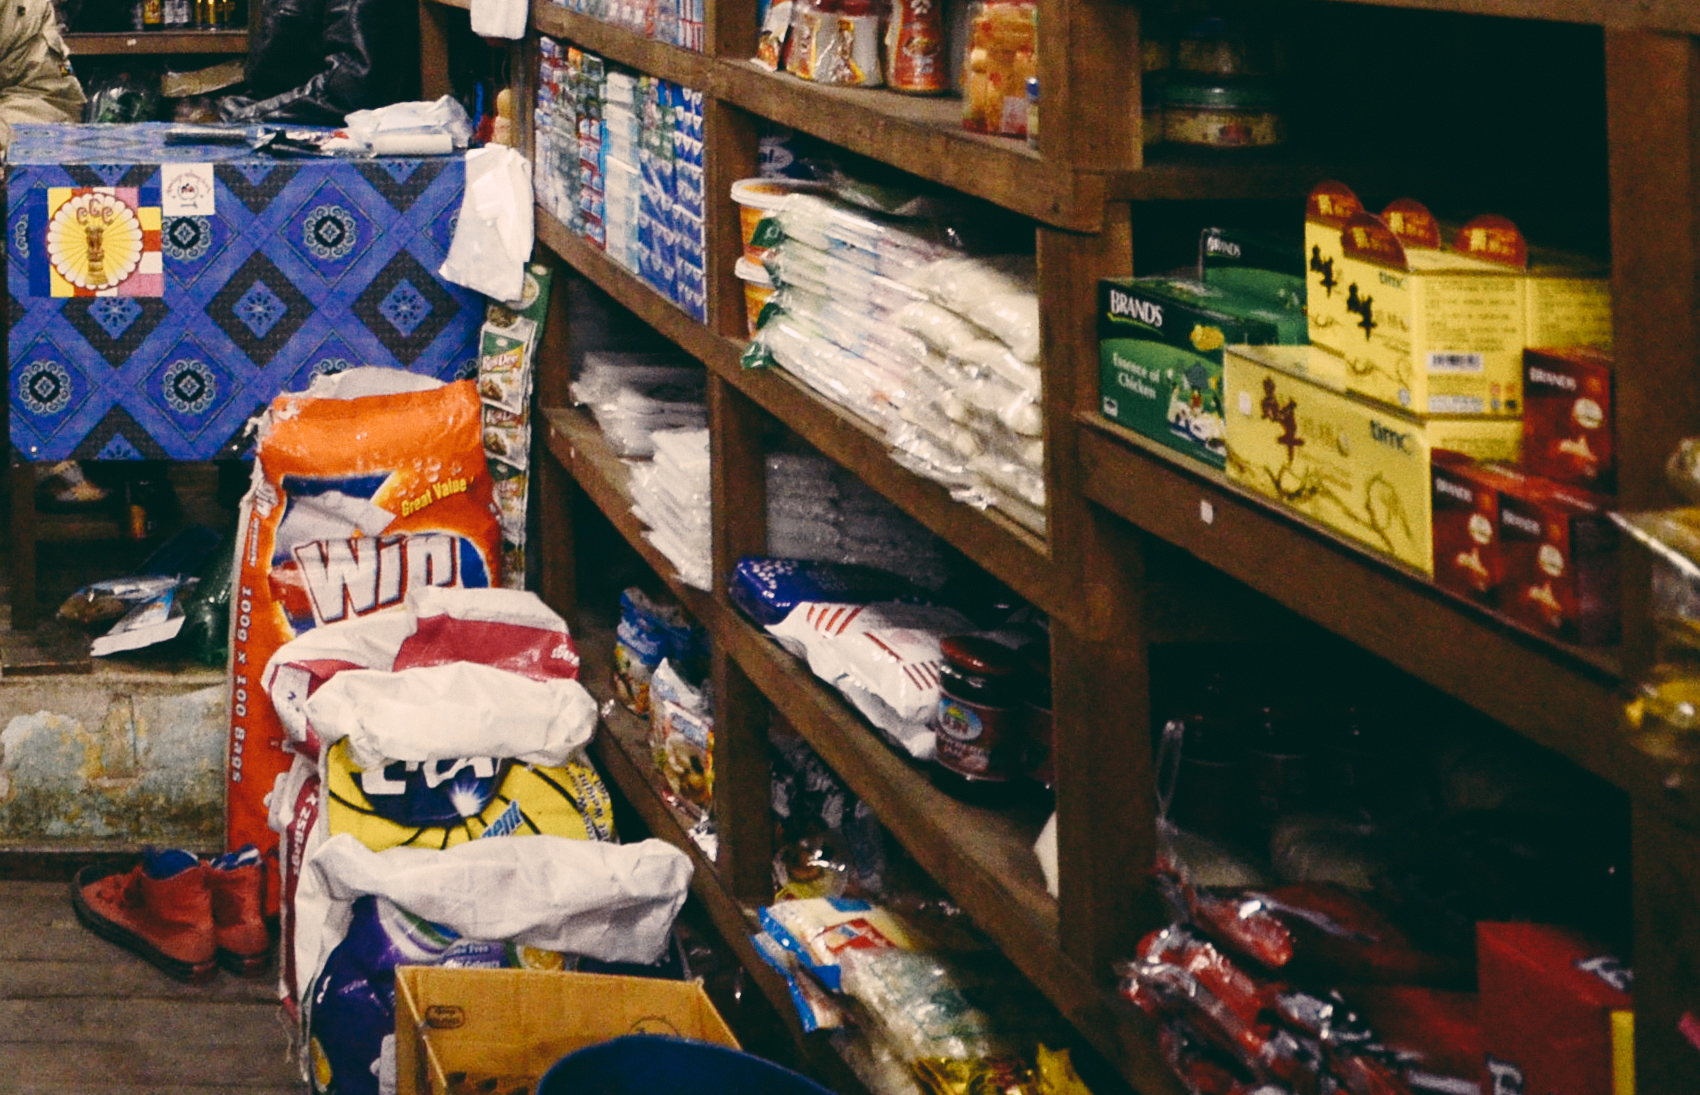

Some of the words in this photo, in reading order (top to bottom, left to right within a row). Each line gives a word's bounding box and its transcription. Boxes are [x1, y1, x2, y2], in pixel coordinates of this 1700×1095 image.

[1113, 352, 1147, 375] Essence
[1149, 369, 1161, 382] of
[1118, 373, 1157, 399] Chicken
[400, 492, 433, 518] Great
[432, 478, 468, 505] Value
[235, 584, 252, 642] 100g
[236, 676, 248, 718] 100
[231, 728, 246, 783] Bags
